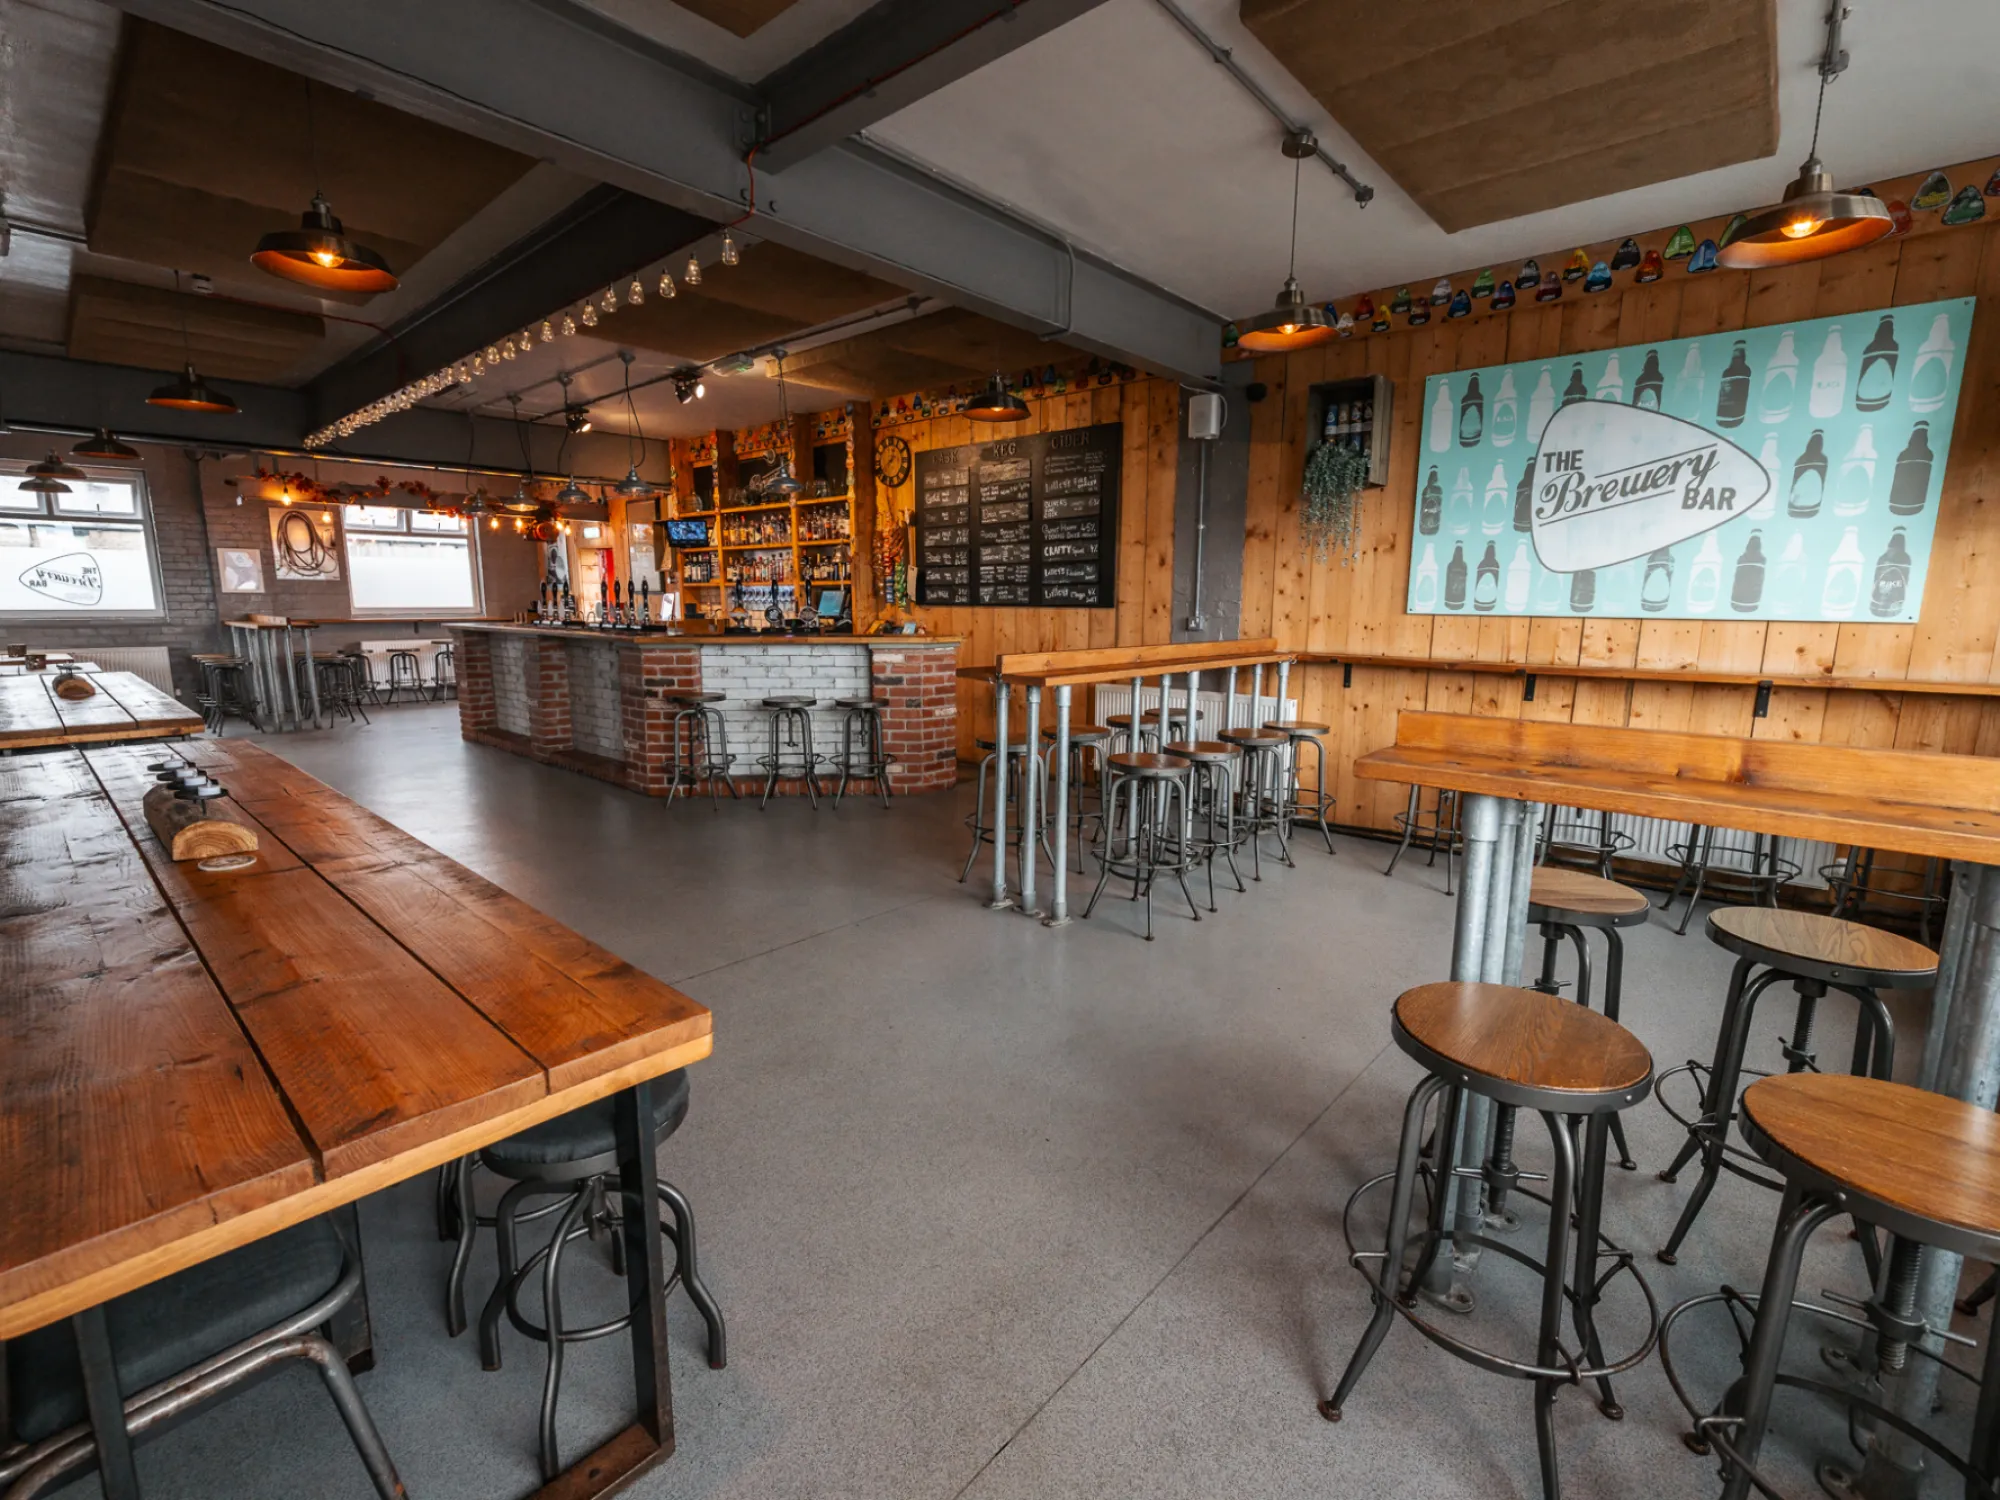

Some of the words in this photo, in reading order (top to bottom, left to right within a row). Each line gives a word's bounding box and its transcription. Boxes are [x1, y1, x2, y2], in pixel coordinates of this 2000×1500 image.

[993, 441, 1016, 457] KEG
[1051, 431, 1089, 449] CIDER
[1543, 450, 1584, 473] THE
[1535, 449, 1720, 520] Brewery
[1681, 487, 1737, 511] BAR
